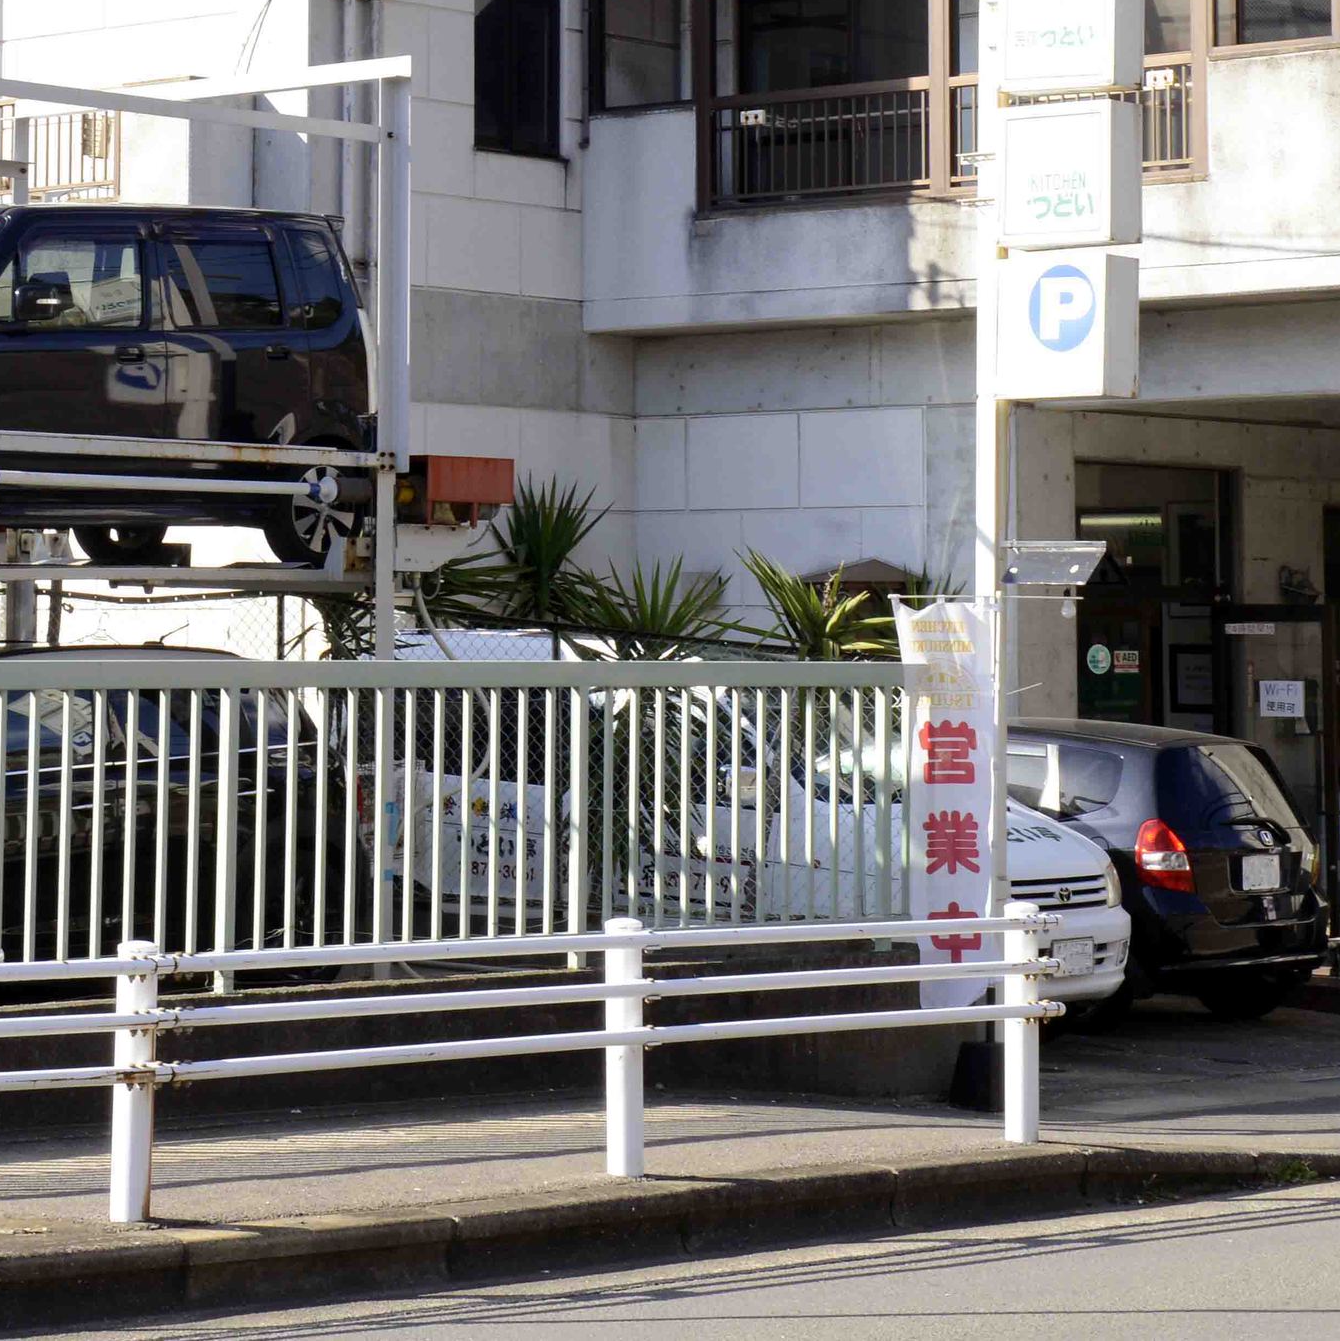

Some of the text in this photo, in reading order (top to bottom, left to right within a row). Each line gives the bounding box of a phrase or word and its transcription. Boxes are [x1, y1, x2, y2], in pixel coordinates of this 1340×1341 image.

[1029, 171, 1086, 191] KITCHEN
[1040, 276, 1093, 340] P
[1265, 683, 1299, 697] Wi-Fi
[1266, 701, 1296, 714] 使用可
[919, 720, 982, 964] 営業中
